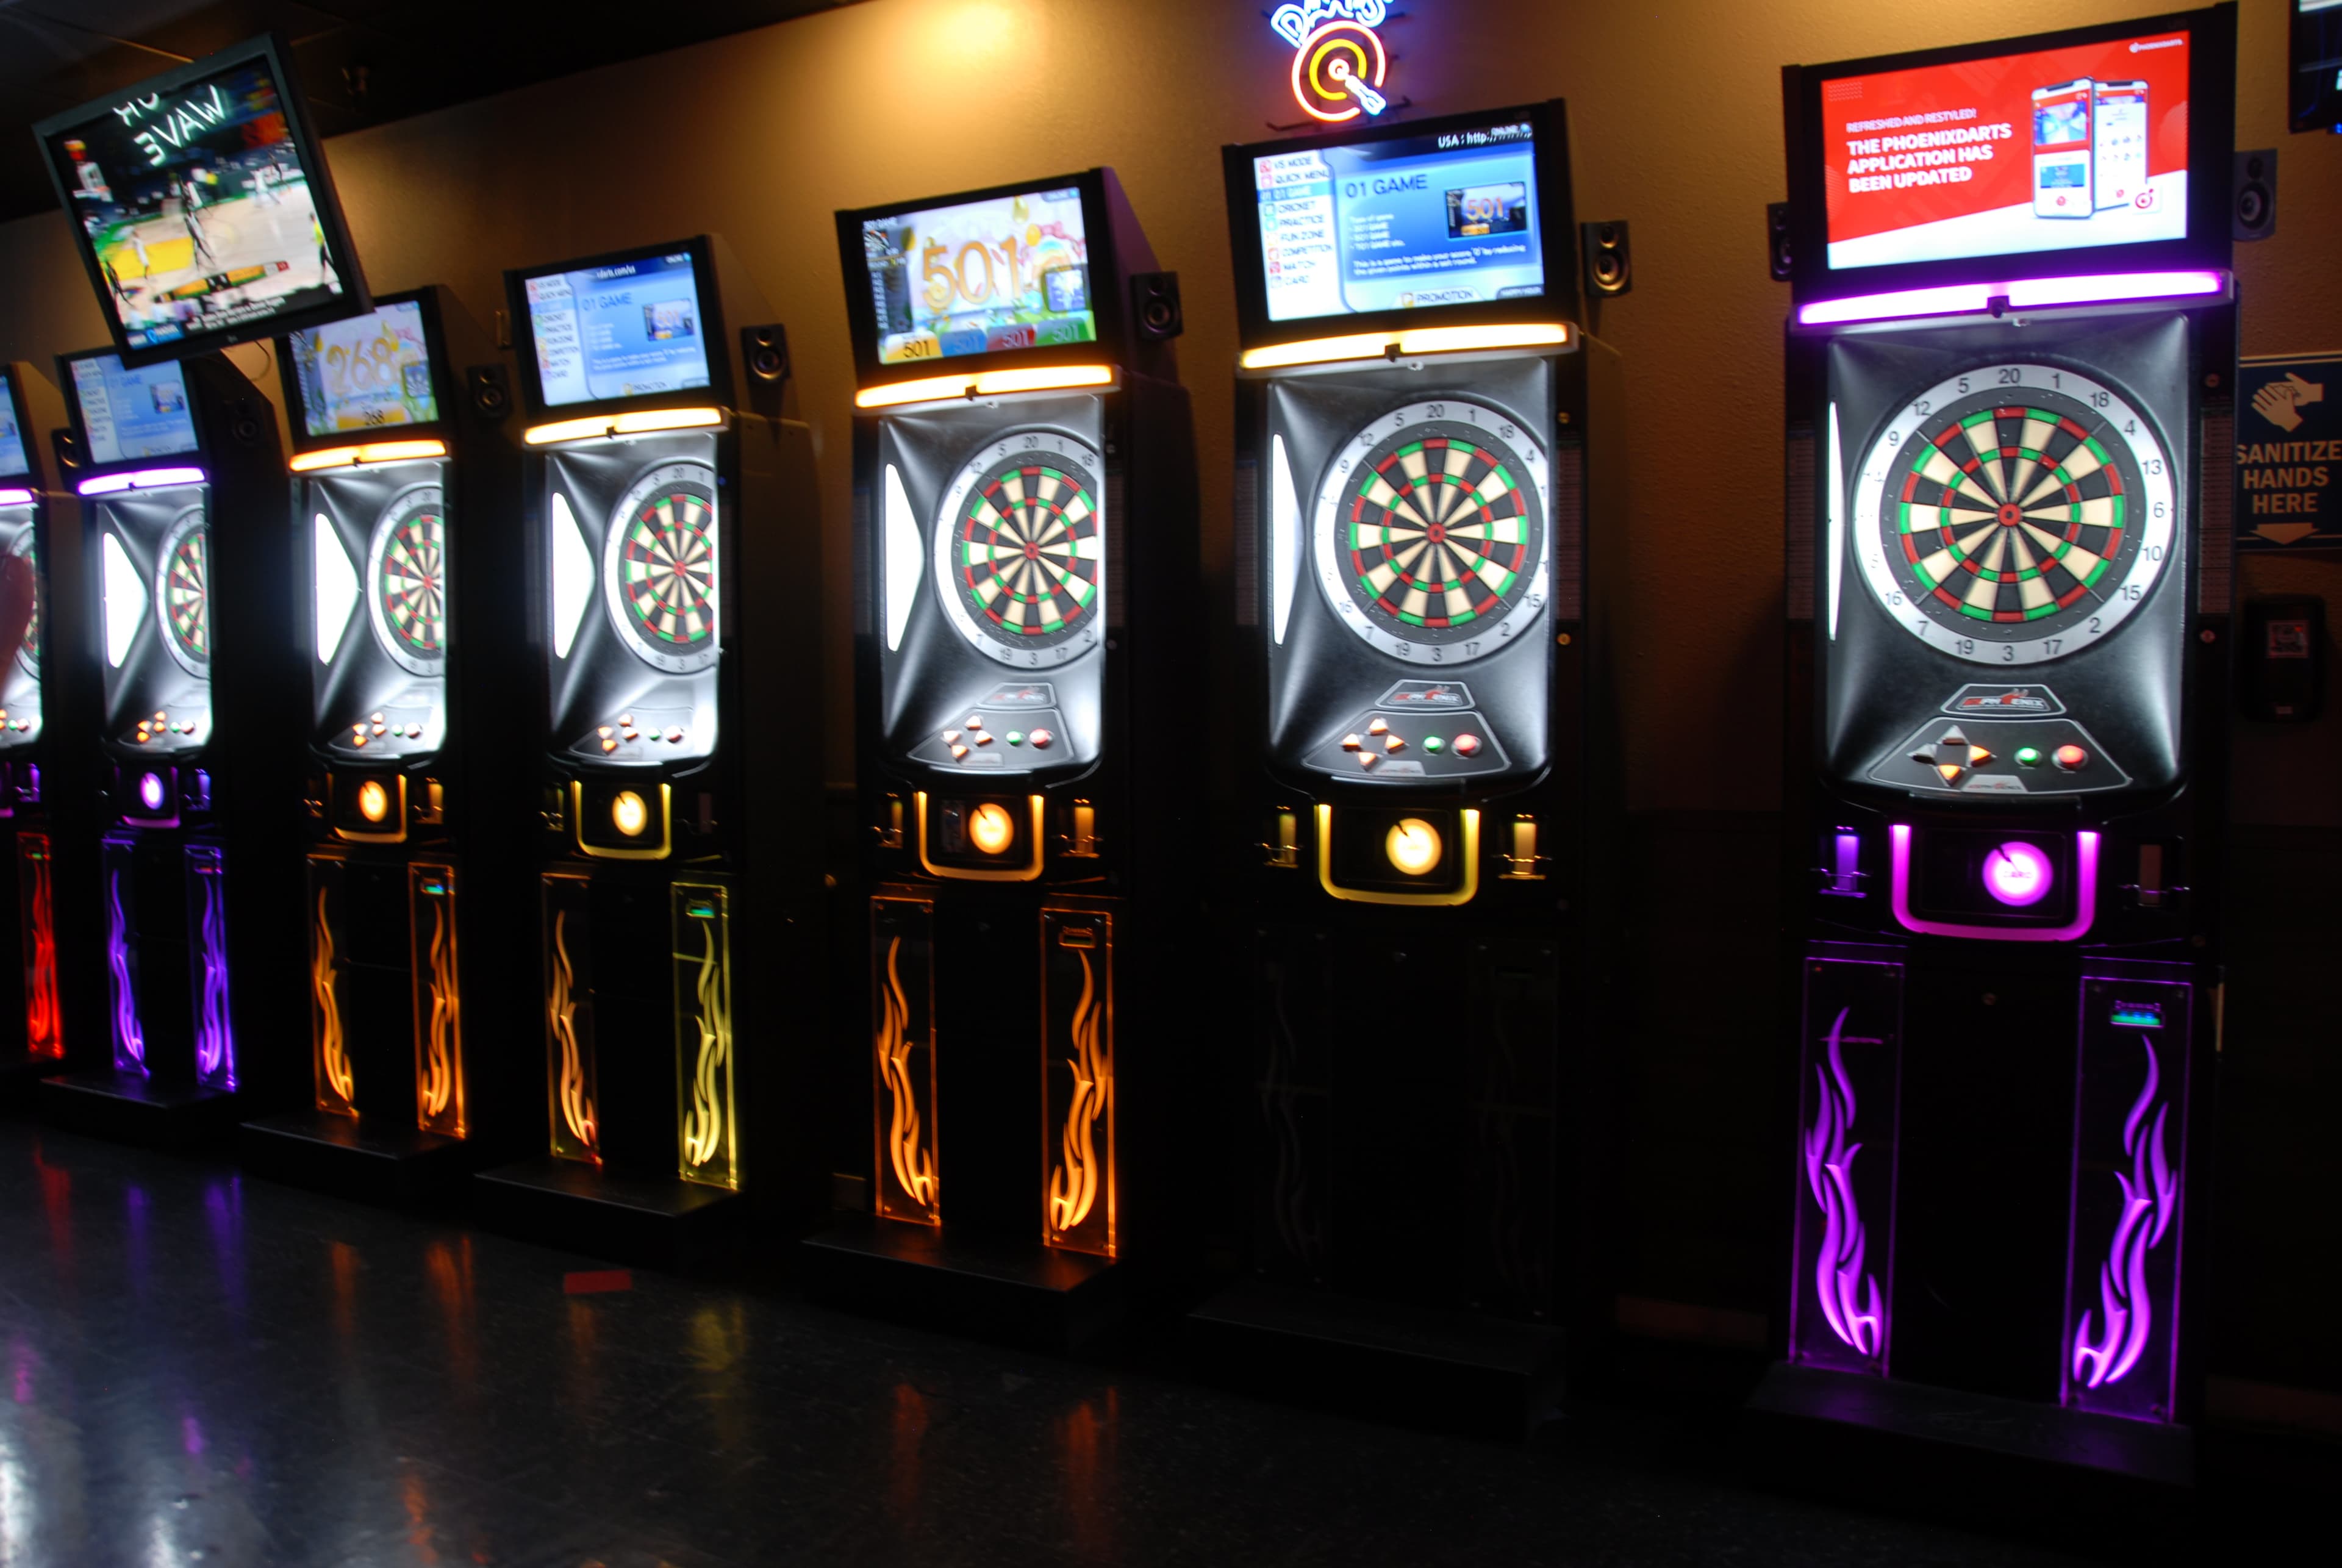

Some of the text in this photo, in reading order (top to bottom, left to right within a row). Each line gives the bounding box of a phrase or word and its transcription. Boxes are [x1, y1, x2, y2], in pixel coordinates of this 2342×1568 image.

[1846, 108, 1977, 133] REFRESHED AND RESTYLED!
[1438, 134, 1459, 149] USA
[1847, 123, 2012, 156] THE PHOENIXDARTS
[1847, 144, 1993, 174] APPLICATION HAS
[1346, 174, 1428, 199] 01 GAME
[1849, 166, 1972, 193] BEEN UPDATED
[1466, 195, 1503, 221] 501
[1280, 214, 1325, 227] PRACTICE
[922, 234, 1022, 312] 501
[1417, 290, 1474, 303] PROMOTION
[1002, 329, 1030, 348] 501
[1052, 324, 1080, 342] 501
[903, 340, 931, 359] 501
[1999, 368, 2021, 384] 20
[2052, 374, 2061, 388] 1
[1958, 378, 1969, 393] 5
[2090, 392, 2110, 407] 18
[1426, 403, 1445, 418] 20
[1469, 409, 1476, 422] 1
[1913, 401, 1931, 416] 12
[1394, 412, 1405, 427] 5
[2124, 419, 2136, 435] 4
[1888, 431, 1899, 446] 9
[1526, 449, 1536, 464] 4
[2236, 440, 2342, 465] SANITIZE
[2143, 460, 2162, 474] 13
[2243, 466, 2330, 489] HANDS
[2154, 502, 2164, 518] 6
[2252, 492, 2319, 514] HERE
[2143, 546, 2163, 561] 10
[1885, 592, 1902, 606] 16
[2121, 584, 2141, 601] 15
[1501, 623, 1511, 637] 2
[1918, 621, 1929, 635] 7
[2089, 617, 2101, 633] 2
[1365, 626, 1375, 640] 7
[1394, 642, 1411, 656] 19
[1464, 642, 1481, 656] 17
[1955, 639, 1974, 654] 19
[2003, 646, 2013, 662] 3
[2043, 639, 2063, 654] 17
[1432, 647, 1442, 662] 3
